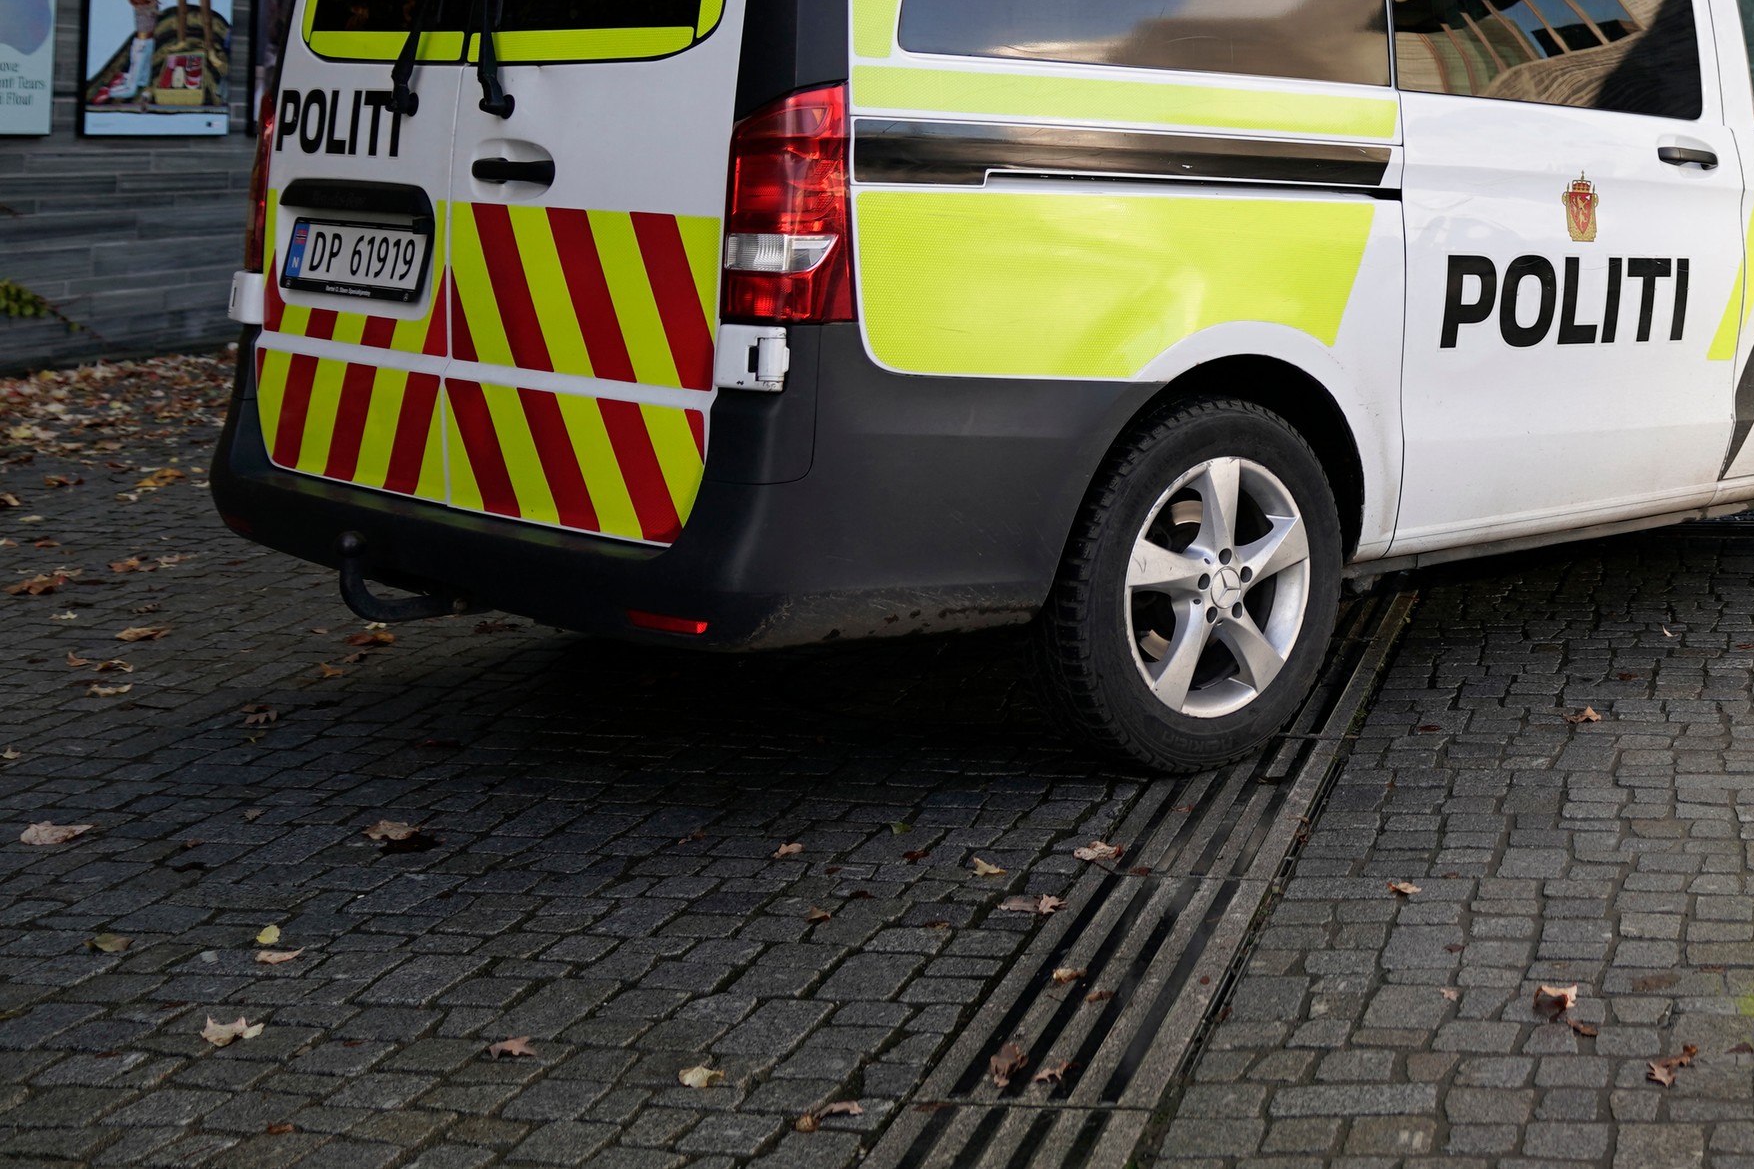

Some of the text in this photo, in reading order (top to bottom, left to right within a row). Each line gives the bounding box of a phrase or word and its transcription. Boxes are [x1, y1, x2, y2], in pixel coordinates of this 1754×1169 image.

[276, 89, 401, 157] POLITI
[291, 256, 300, 268] N
[309, 232, 416, 281] DP 61919
[1440, 254, 1689, 348] POLITI
